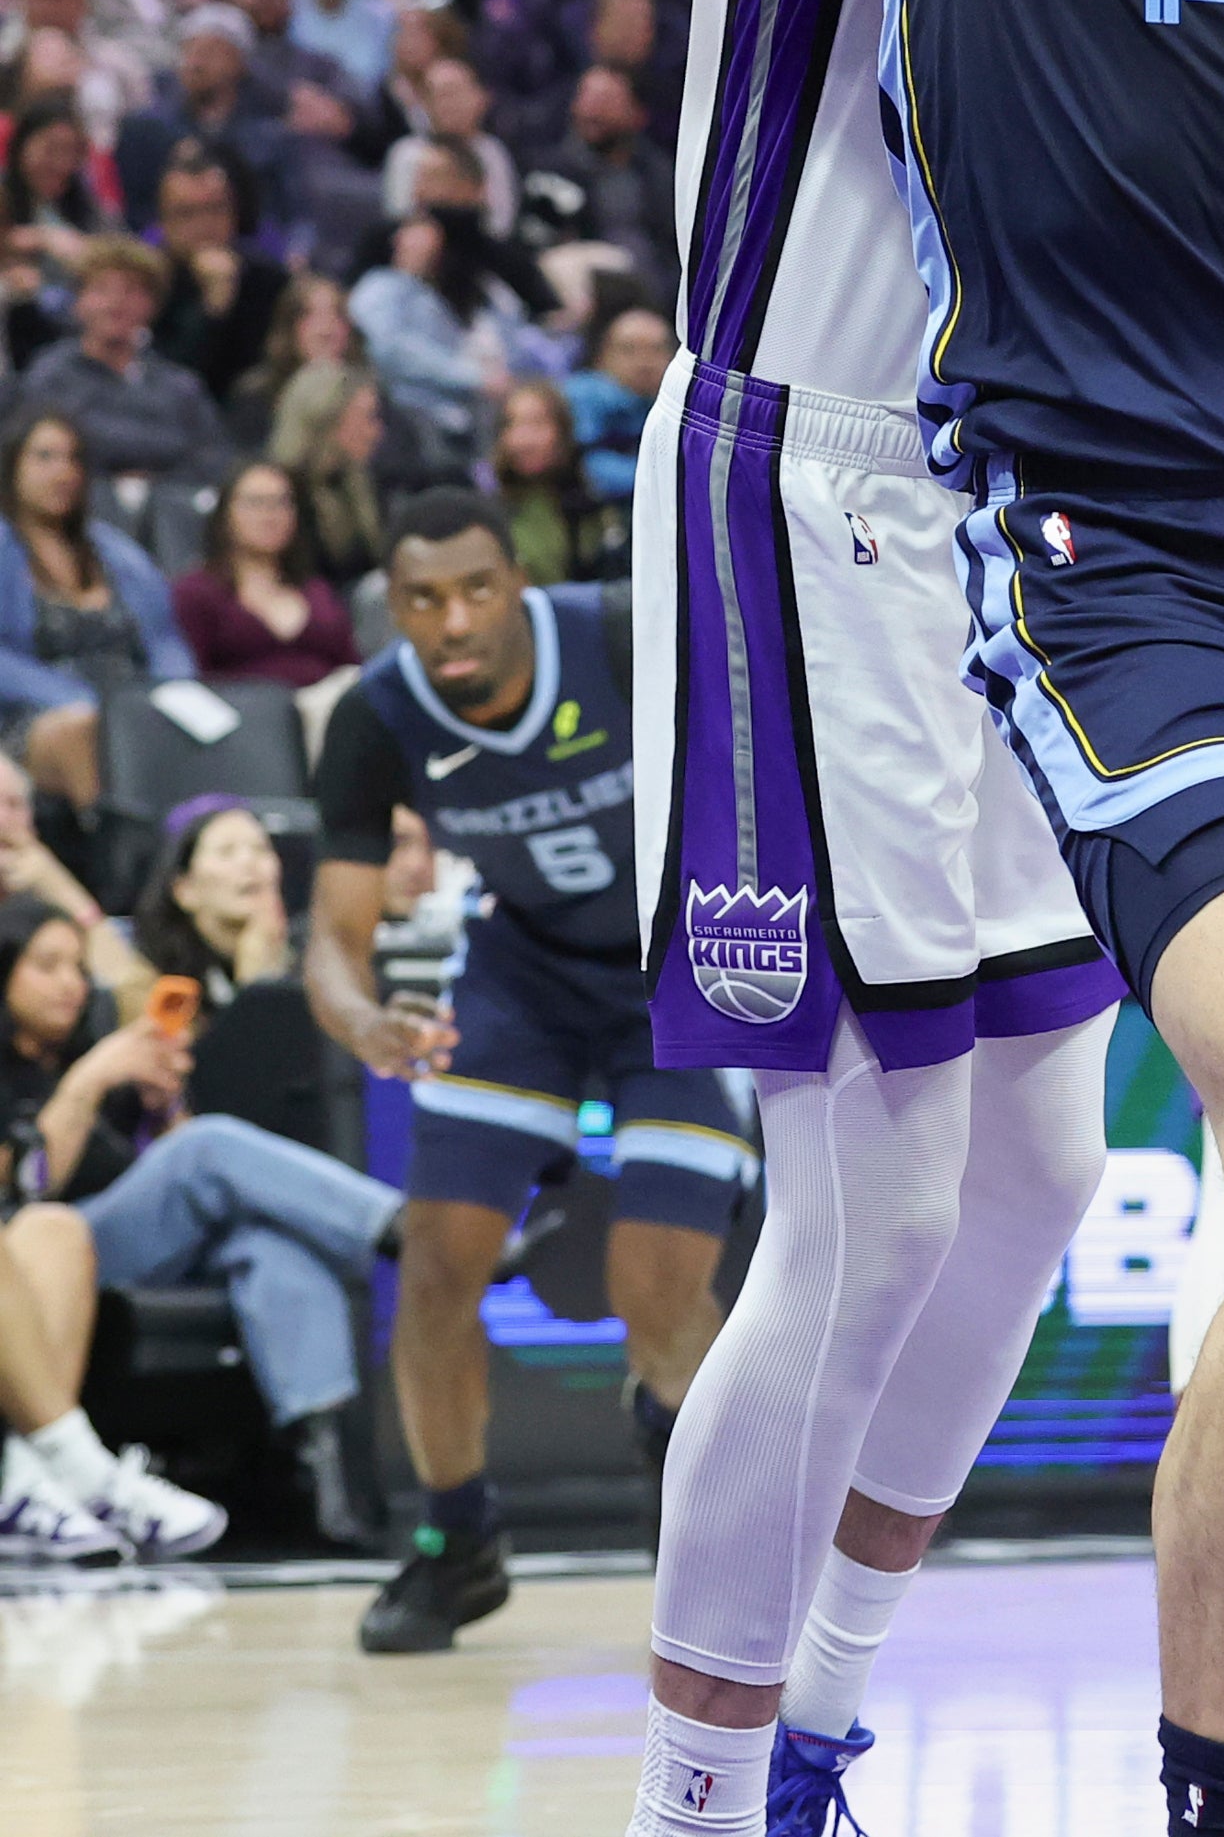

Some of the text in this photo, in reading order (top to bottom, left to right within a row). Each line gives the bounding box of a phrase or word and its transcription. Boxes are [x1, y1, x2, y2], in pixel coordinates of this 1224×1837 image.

[525, 825, 616, 893] 5
[693, 925, 798, 940] SACRAMENTO
[693, 940, 803, 973] KINGS
